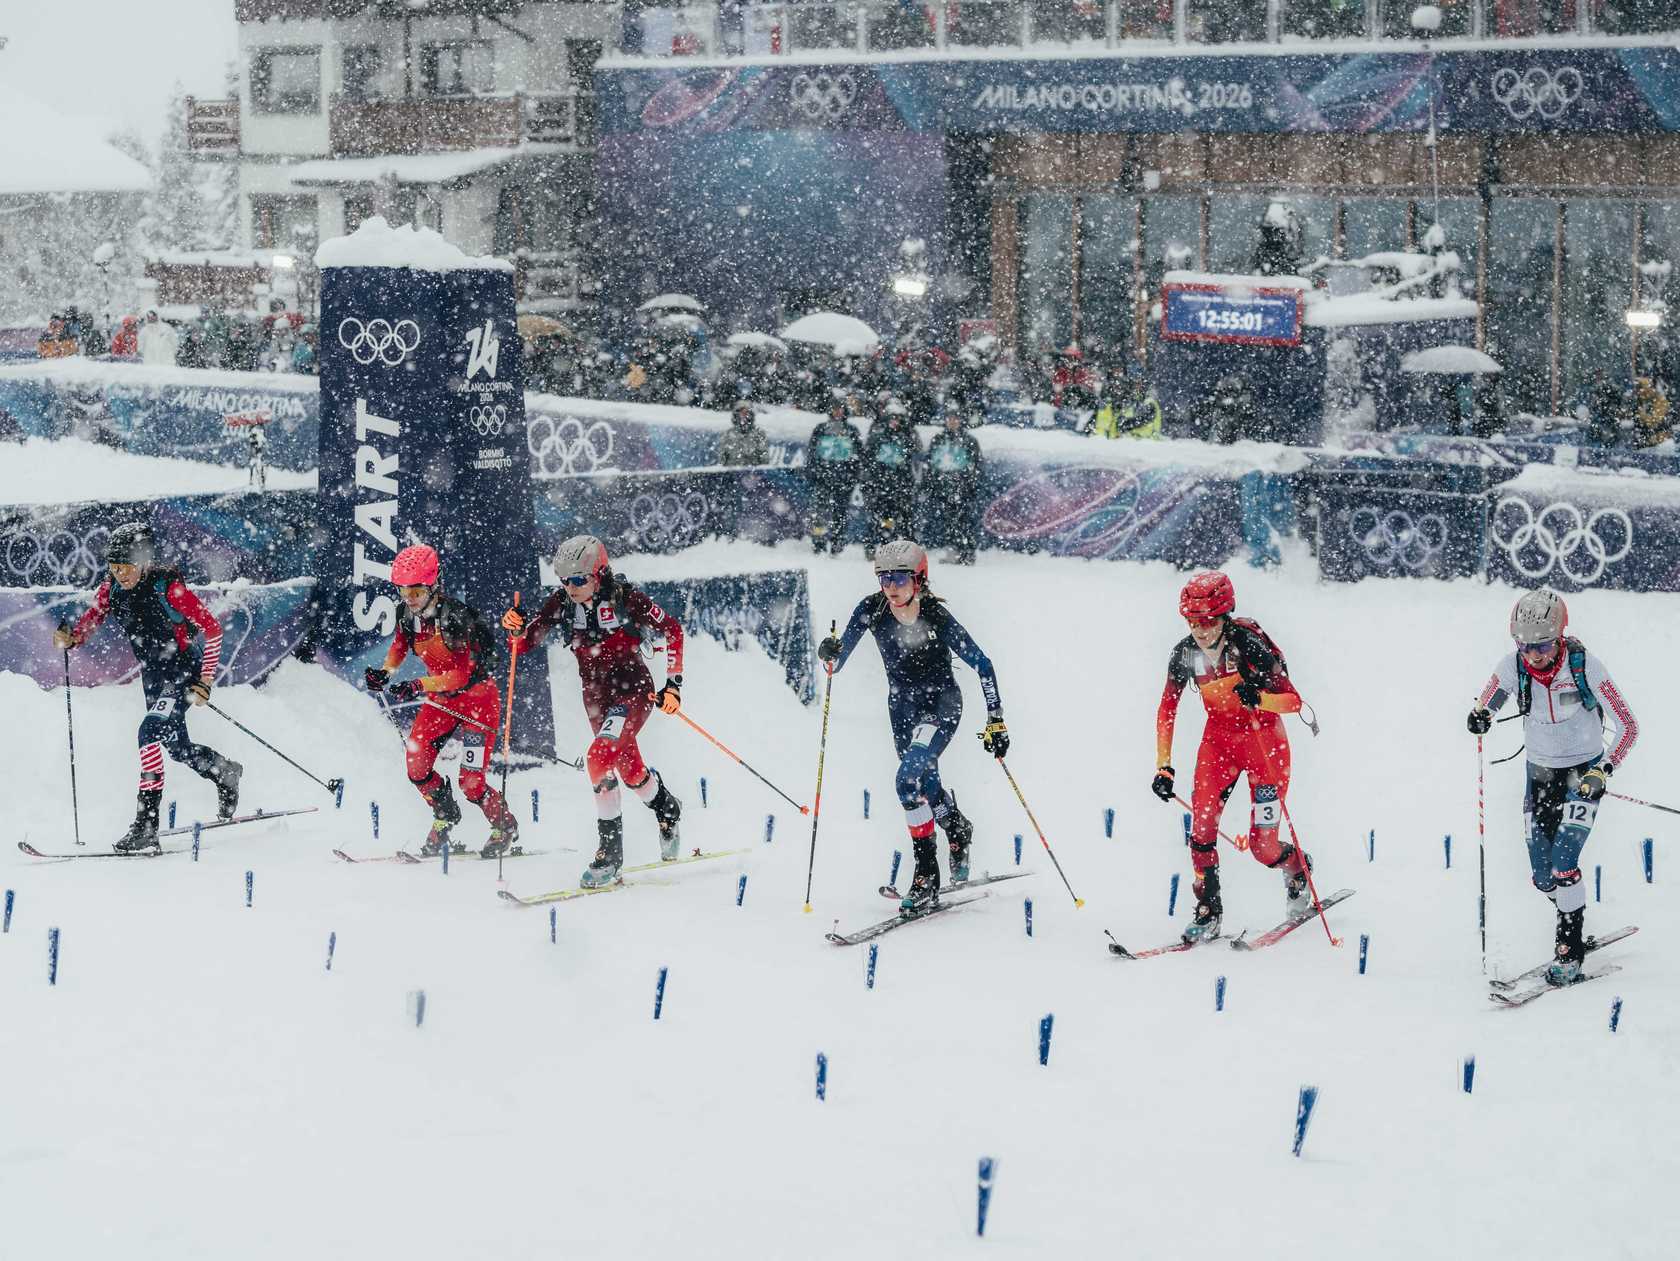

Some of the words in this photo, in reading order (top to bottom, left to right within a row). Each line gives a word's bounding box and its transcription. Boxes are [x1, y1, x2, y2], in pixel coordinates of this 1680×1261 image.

[971, 85, 1075, 110] MILANO
[1198, 82, 1253, 108] 2026
[1199, 310, 1263, 331] 12:55:01
[170, 389, 236, 413] MILANO
[352, 398, 401, 637] START
[603, 719, 613, 731] 2
[465, 750, 475, 763] 9
[1263, 806, 1274, 820] 3
[1569, 804, 1587, 821] 12
